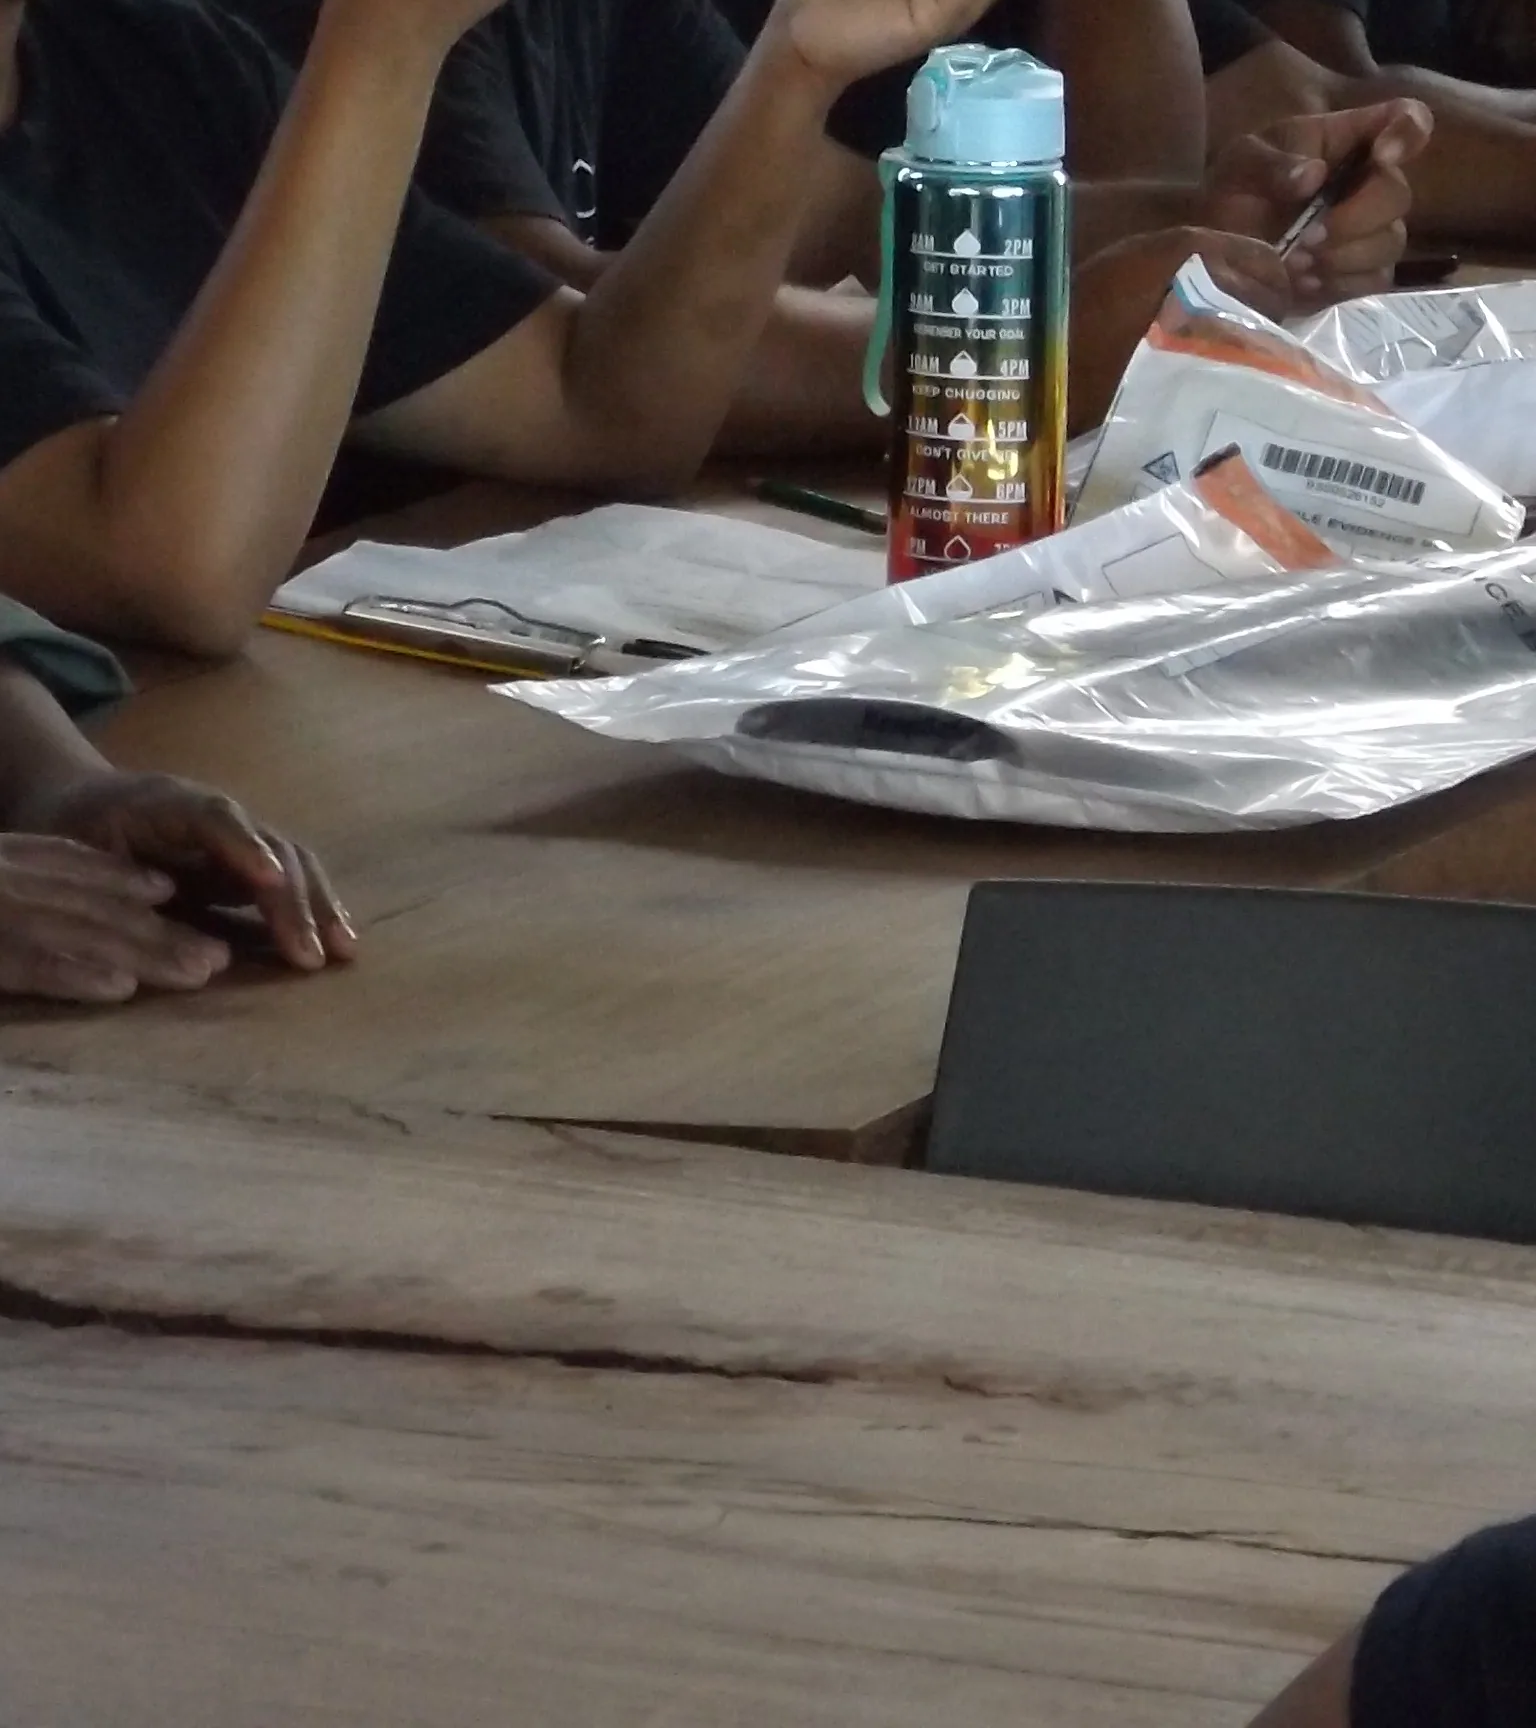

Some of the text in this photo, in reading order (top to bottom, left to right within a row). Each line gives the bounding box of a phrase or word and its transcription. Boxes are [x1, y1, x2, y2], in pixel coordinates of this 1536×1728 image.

[1003, 238, 1033, 257] 2PM
[1001, 298, 1031, 317] 3PM
[965, 327, 996, 340] YOUR
[910, 353, 1030, 377] 10AM 4PM
[998, 419, 1028, 439] 5PM
[996, 481, 1026, 500] 6PM
[910, 505, 1010, 525] ALMOST THERE
